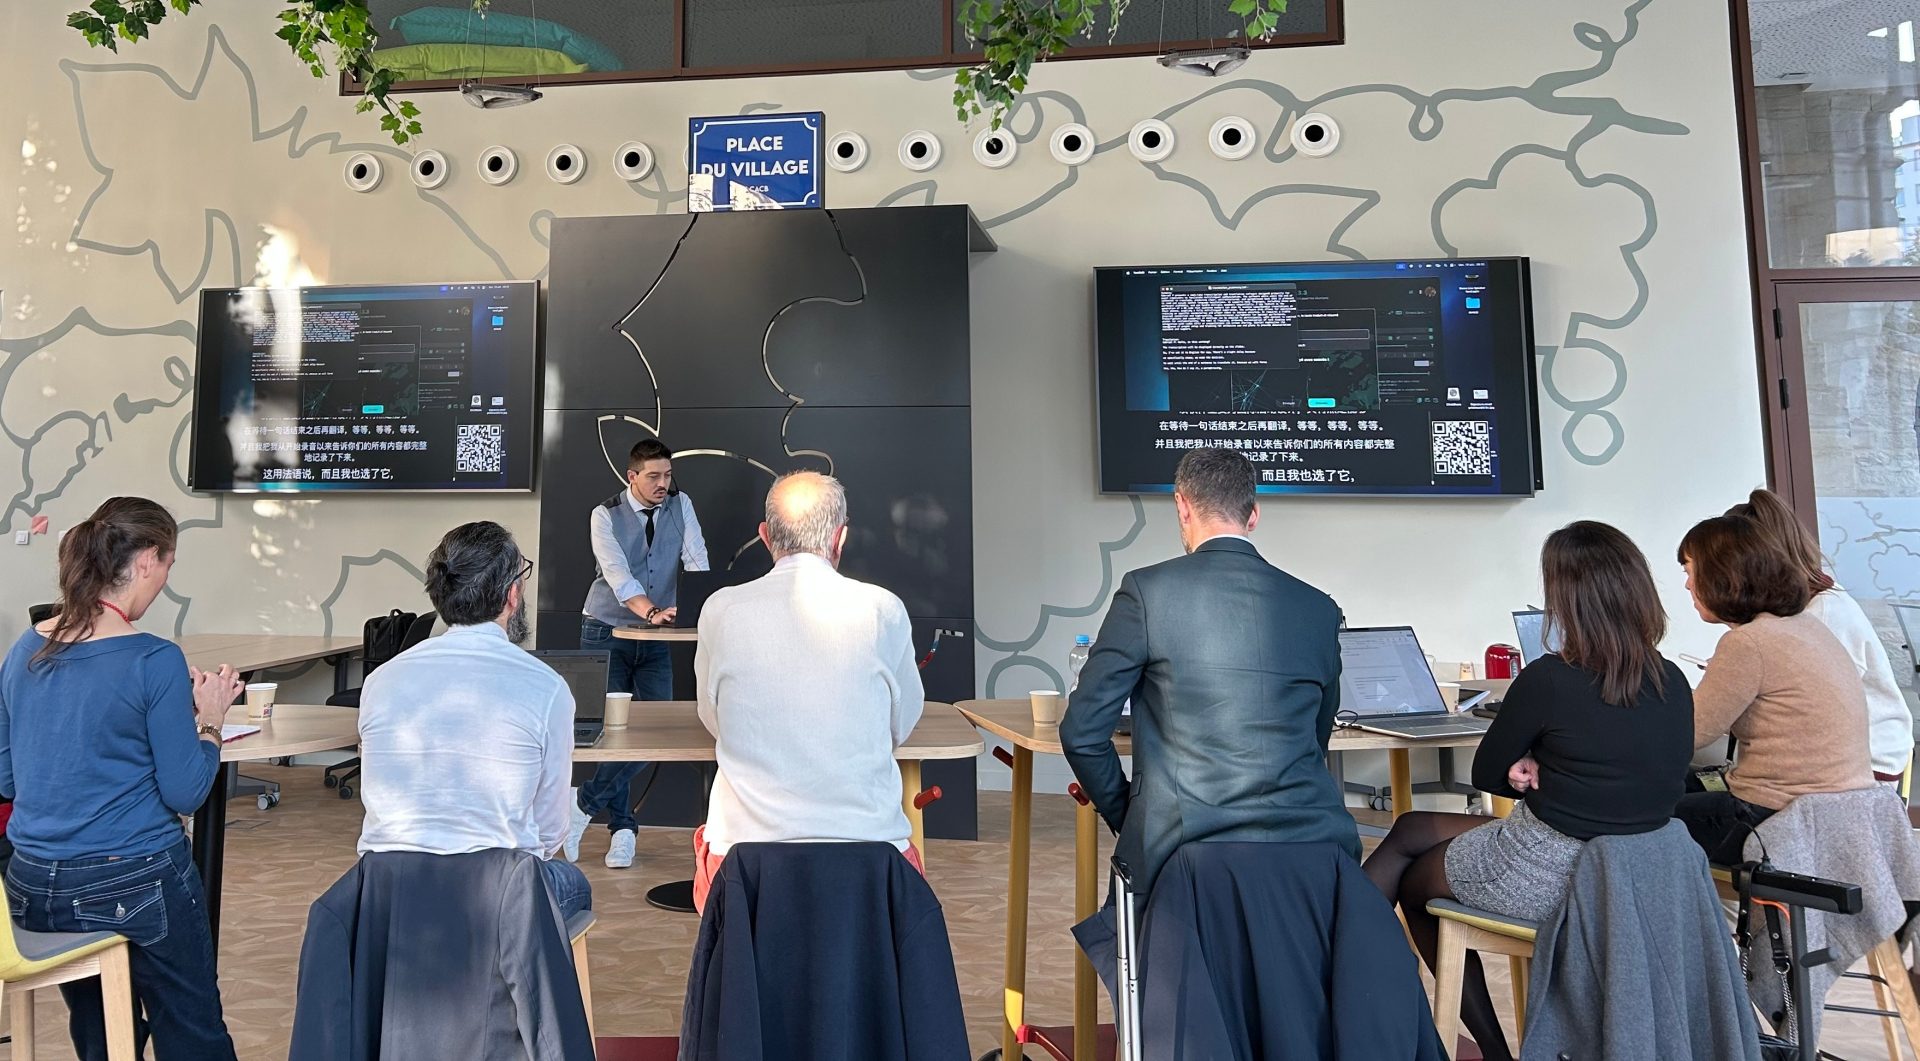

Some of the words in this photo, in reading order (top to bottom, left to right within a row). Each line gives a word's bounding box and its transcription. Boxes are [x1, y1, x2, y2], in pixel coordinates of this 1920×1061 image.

[726, 135, 784, 153] PLACE
[700, 162, 726, 178] DU
[731, 159, 809, 177] VILLAGE
